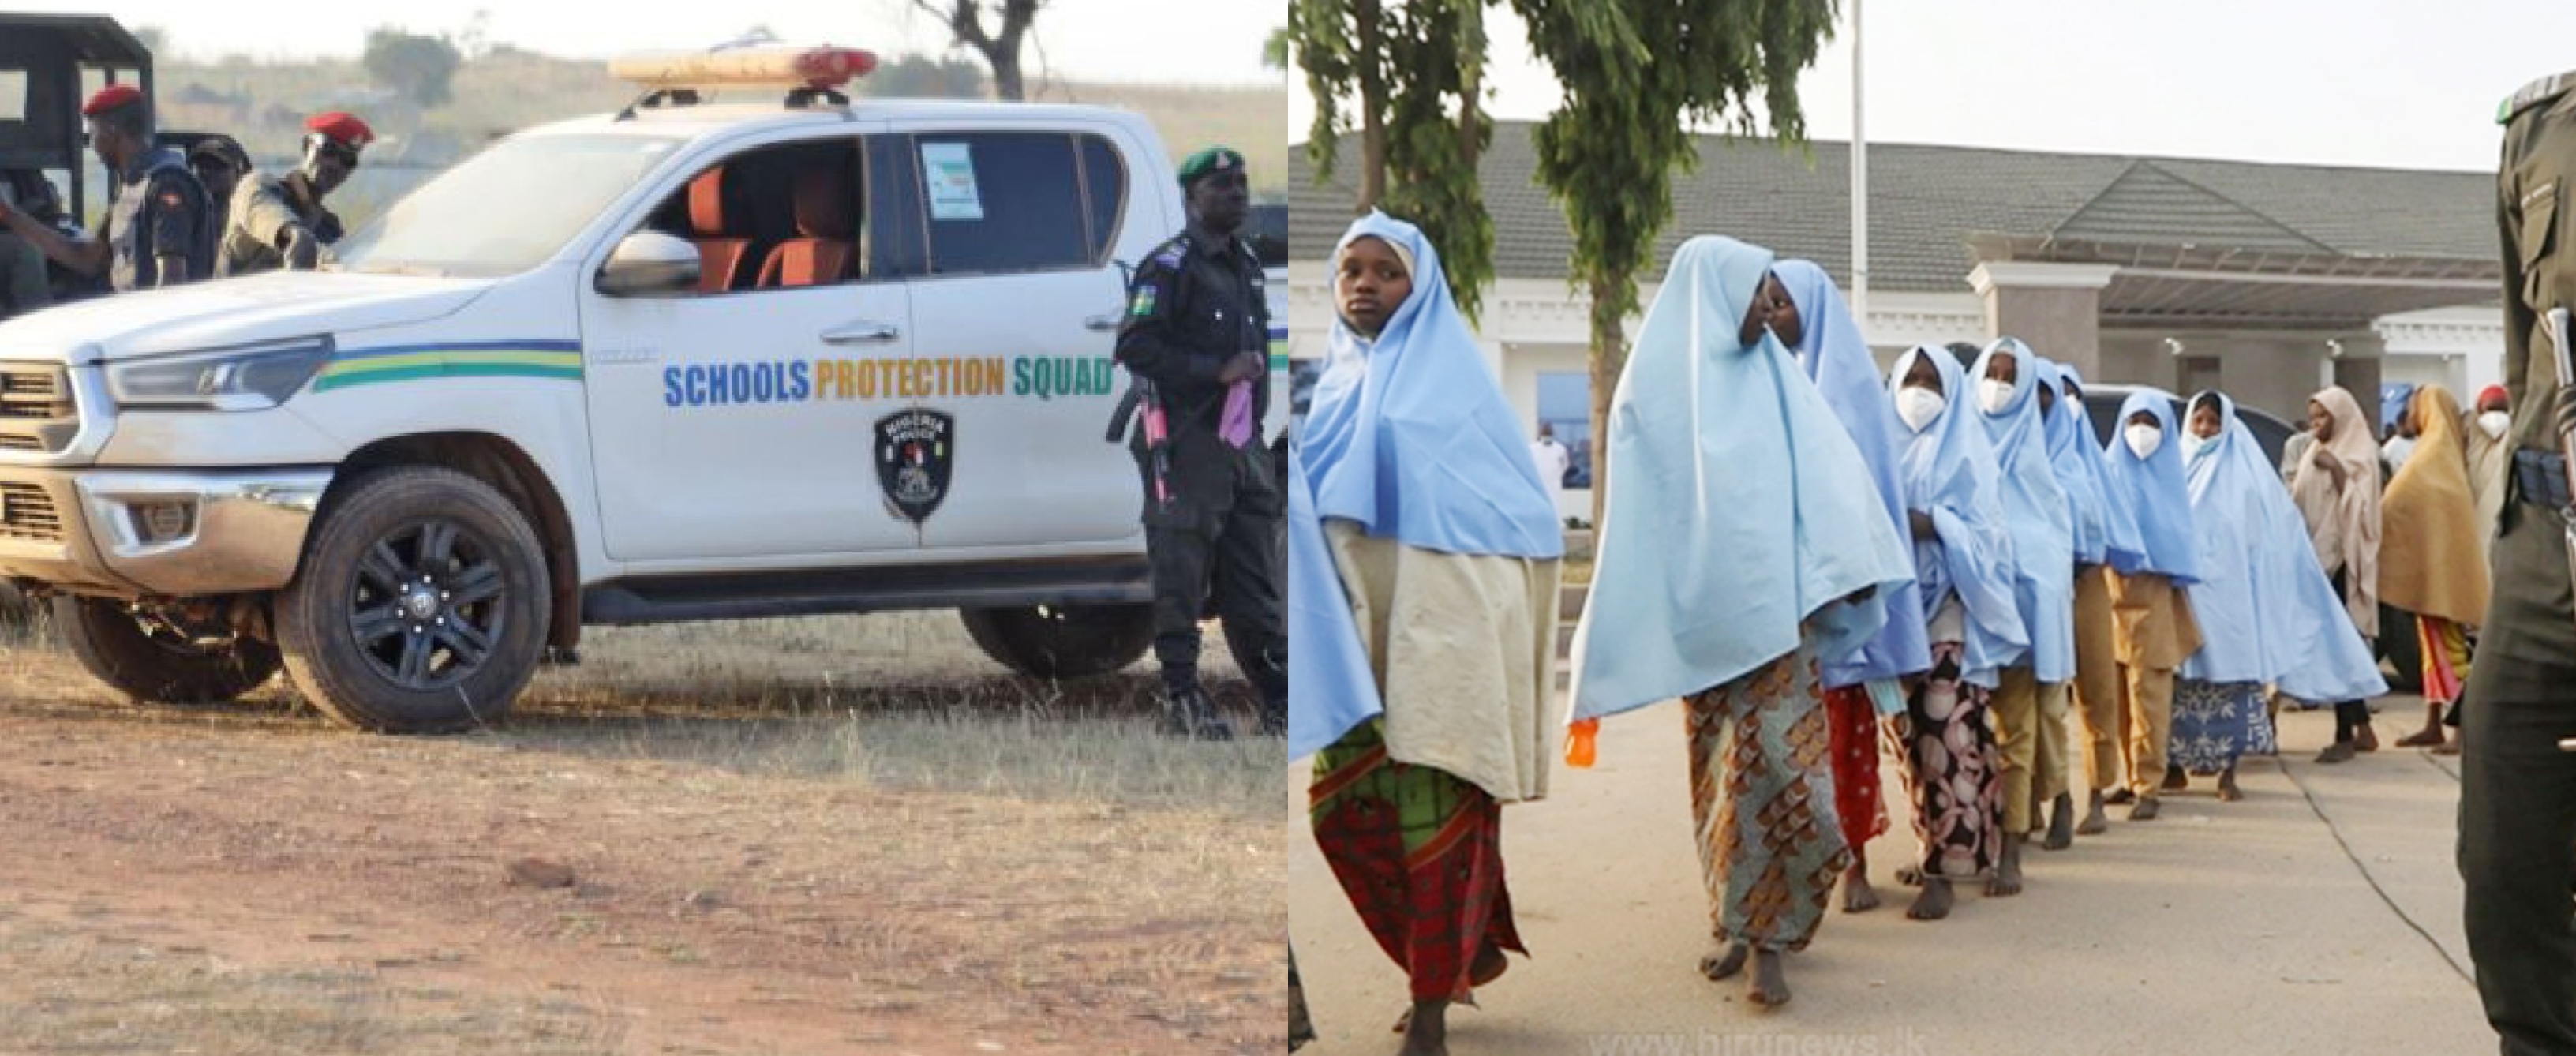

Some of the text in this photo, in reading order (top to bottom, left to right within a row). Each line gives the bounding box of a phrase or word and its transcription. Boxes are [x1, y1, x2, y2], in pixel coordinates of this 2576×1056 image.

[664, 354, 1114, 407] SCHOOLS PROTECTION SQUAD
